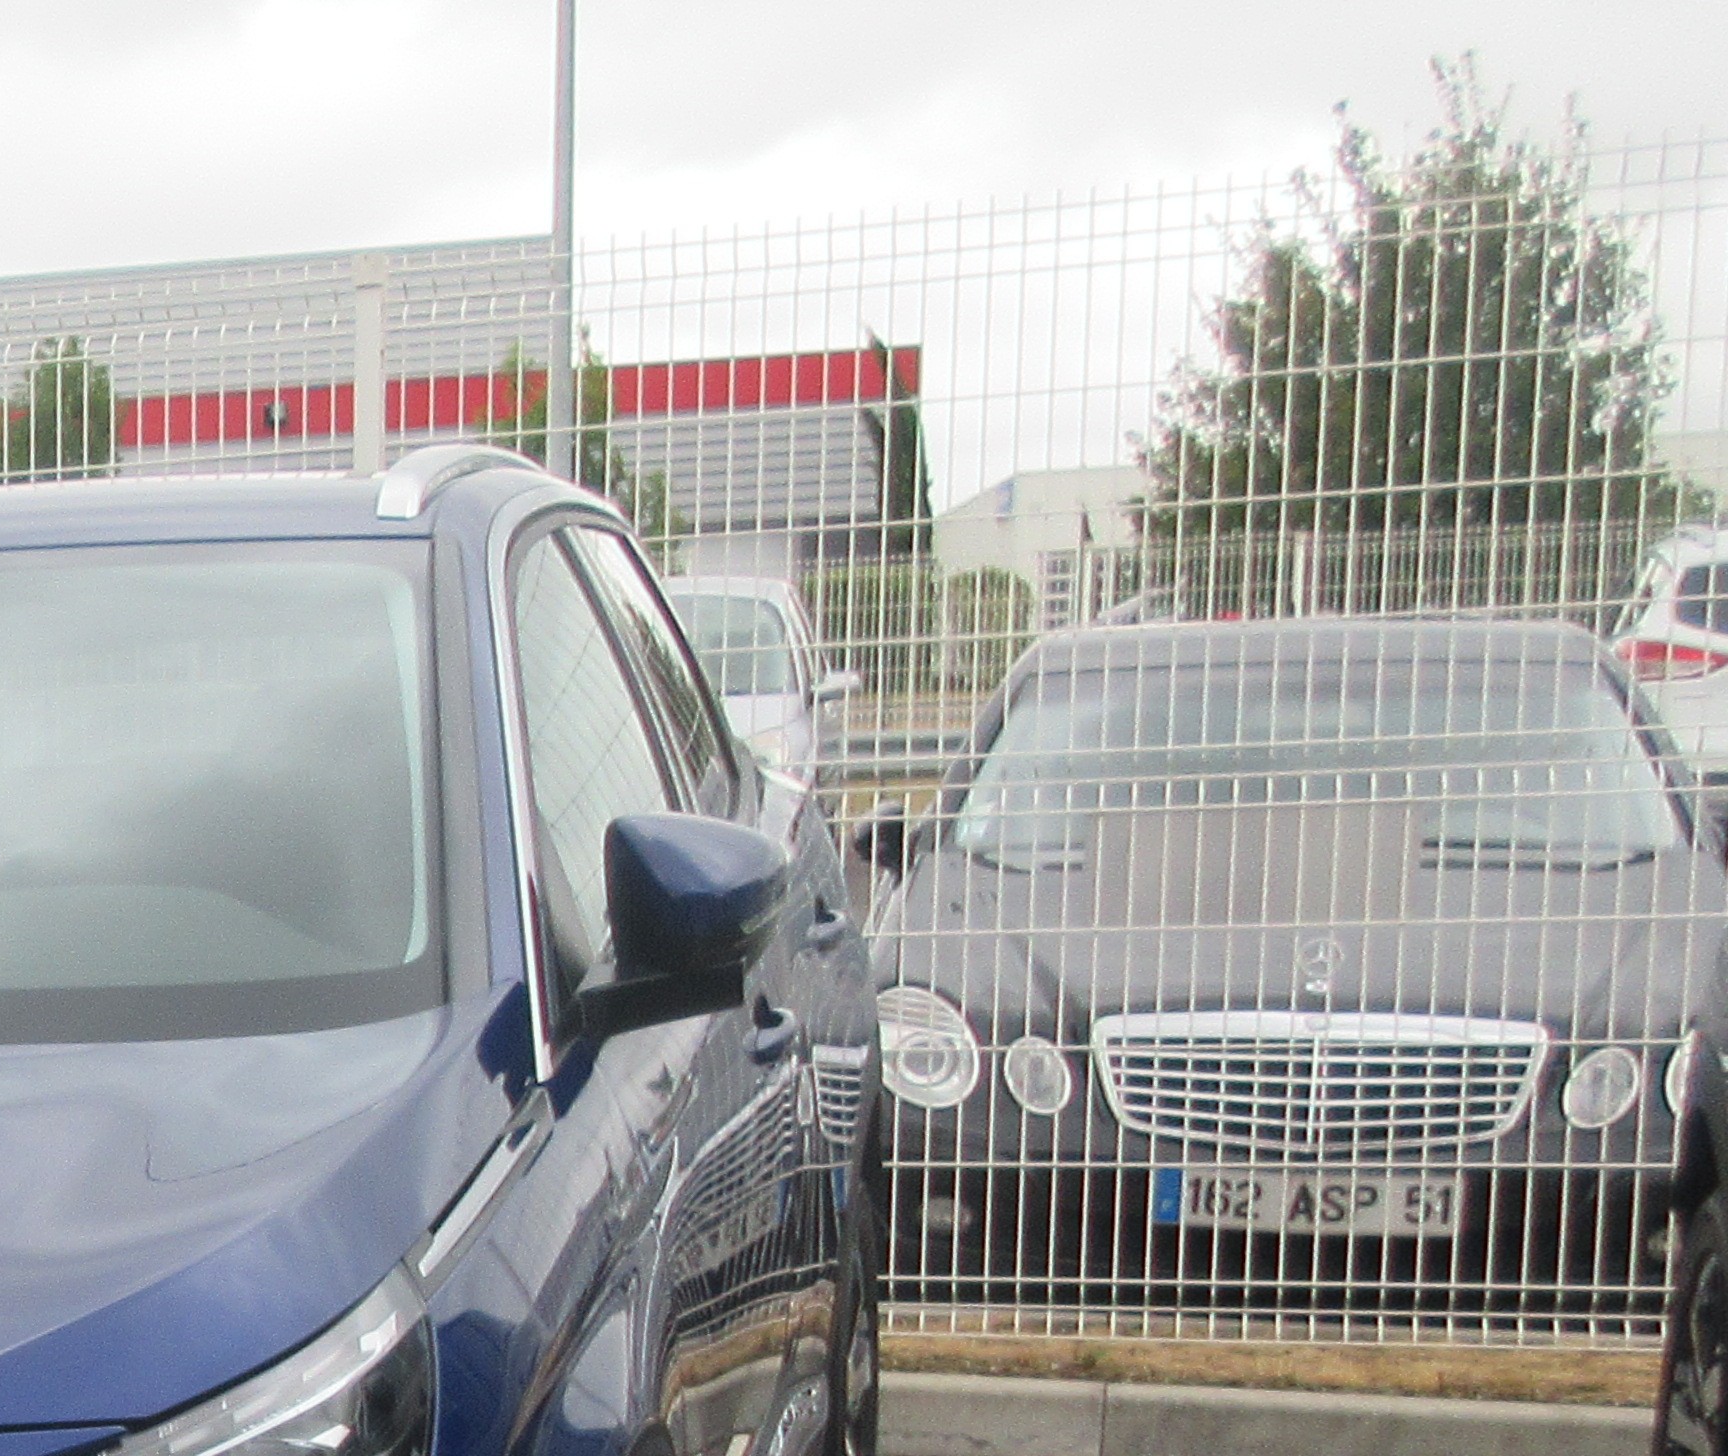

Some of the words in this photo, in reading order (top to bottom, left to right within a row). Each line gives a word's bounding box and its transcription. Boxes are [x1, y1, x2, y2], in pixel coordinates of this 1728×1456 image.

[1189, 1176, 1262, 1219] 162
[1290, 1183, 1379, 1223] ASP
[1404, 1183, 1452, 1225] 51
